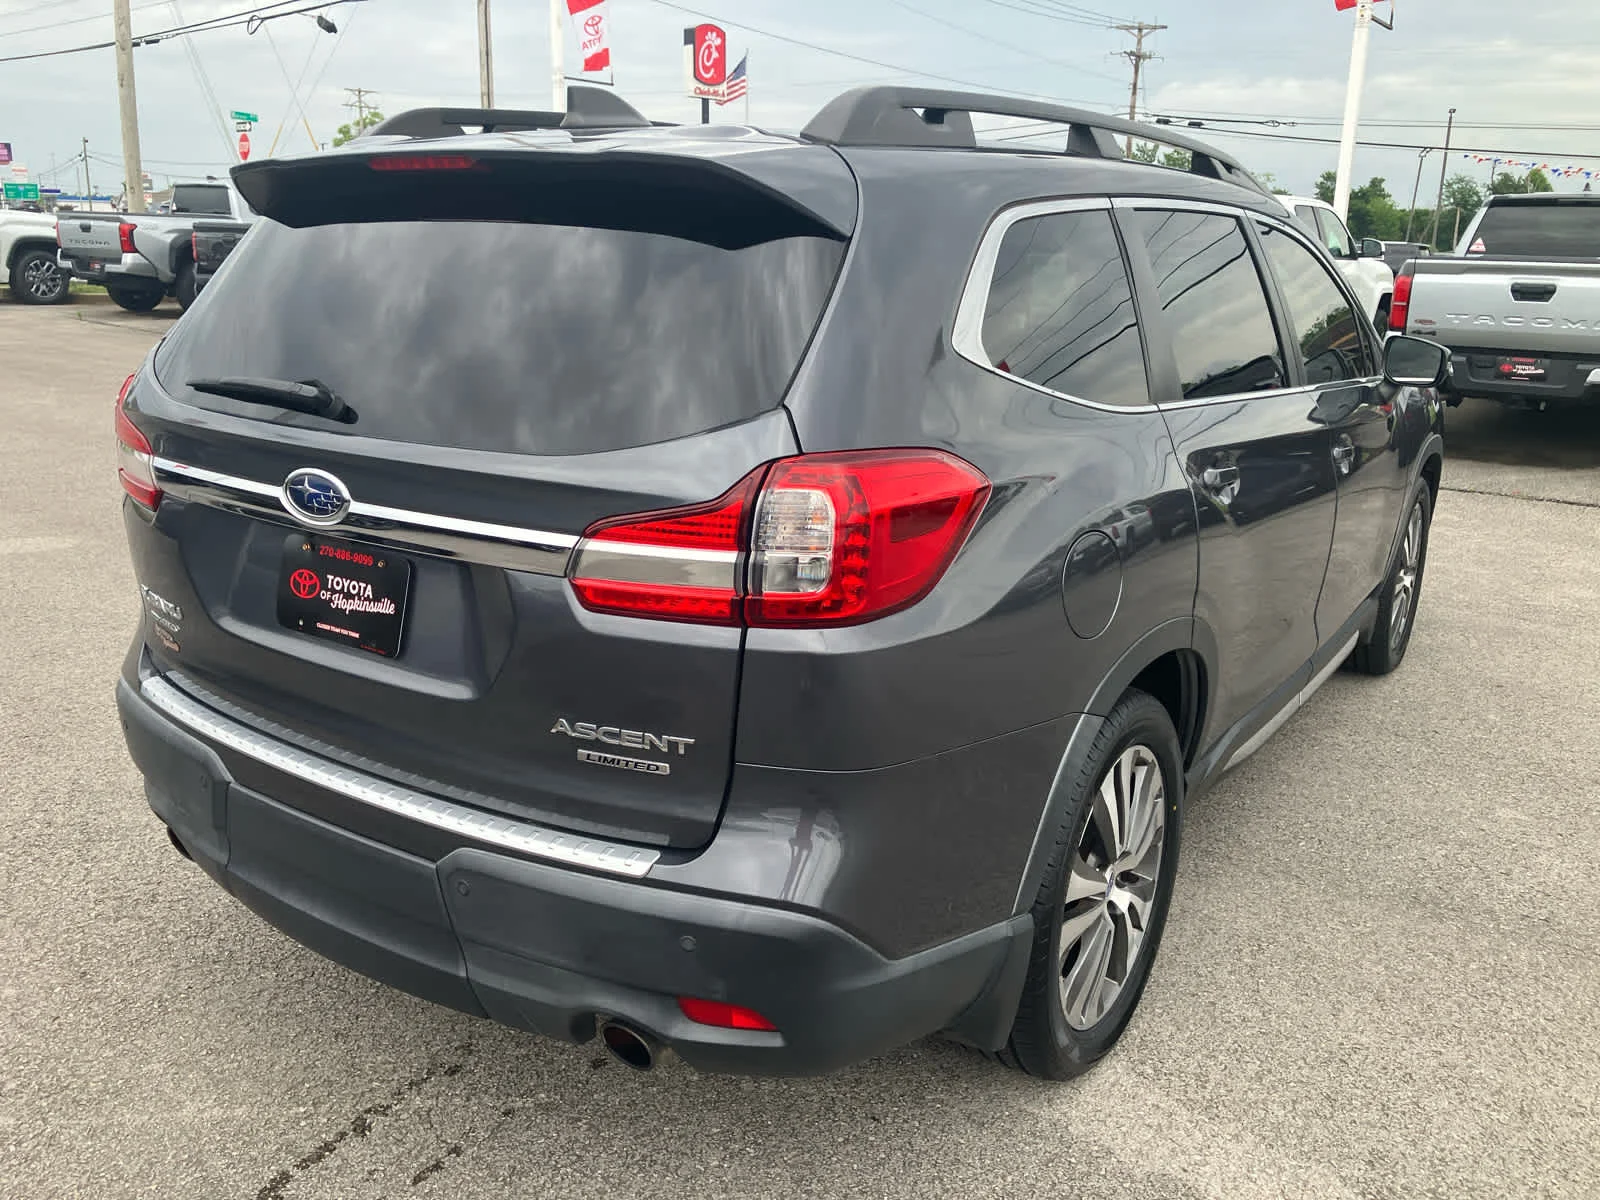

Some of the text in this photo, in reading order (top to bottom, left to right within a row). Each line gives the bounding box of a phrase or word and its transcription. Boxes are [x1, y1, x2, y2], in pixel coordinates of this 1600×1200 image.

[326, 574, 373, 599] TOYOTA
[320, 590, 395, 615] OF Hopkinsville
[550, 718, 695, 755] ASCENT
[586, 753, 659, 772] LIMITED
